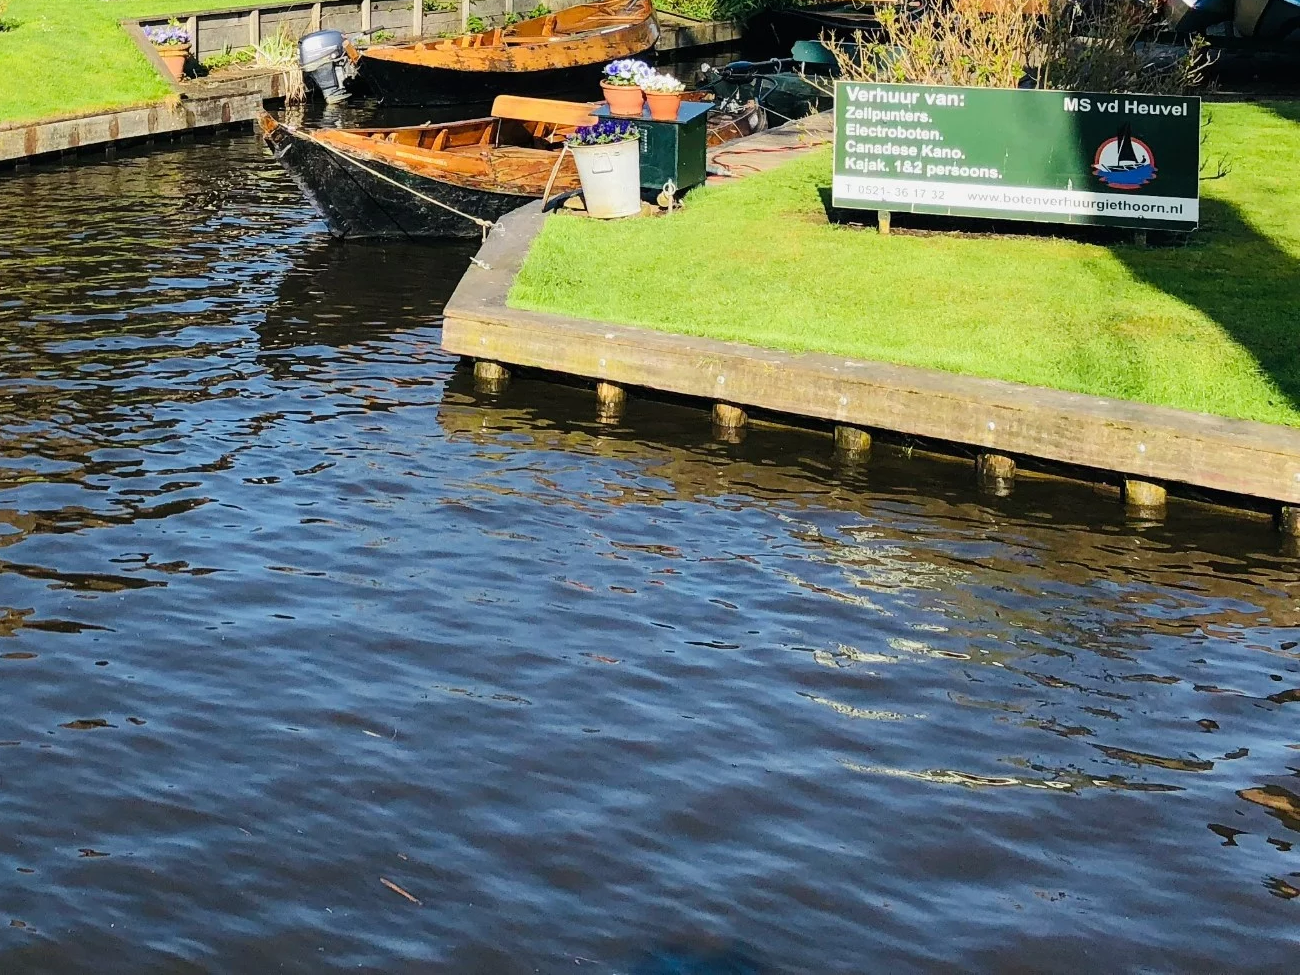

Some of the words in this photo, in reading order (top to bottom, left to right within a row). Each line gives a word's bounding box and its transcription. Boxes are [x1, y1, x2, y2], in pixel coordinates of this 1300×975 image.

[845, 85, 920, 105] Verhuur
[925, 92, 965, 107] van:
[1063, 97, 1091, 112] MS
[1097, 99, 1118, 113] vd
[1125, 100, 1188, 116] Heuvel
[845, 123, 944, 141] Electroboten.
[845, 140, 917, 156] Canadese
[922, 144, 965, 159] Kano.
[845, 157, 890, 173] Kajak.
[894, 160, 922, 174] 1&2
[926, 163, 1003, 179] persoons.
[845, 184, 852, 193] T
[895, 187, 909, 197] 36
[914, 189, 926, 198] 17
[932, 190, 945, 200] 32
[967, 192, 1183, 215] www.botenverhuurgiethoorn.nl
